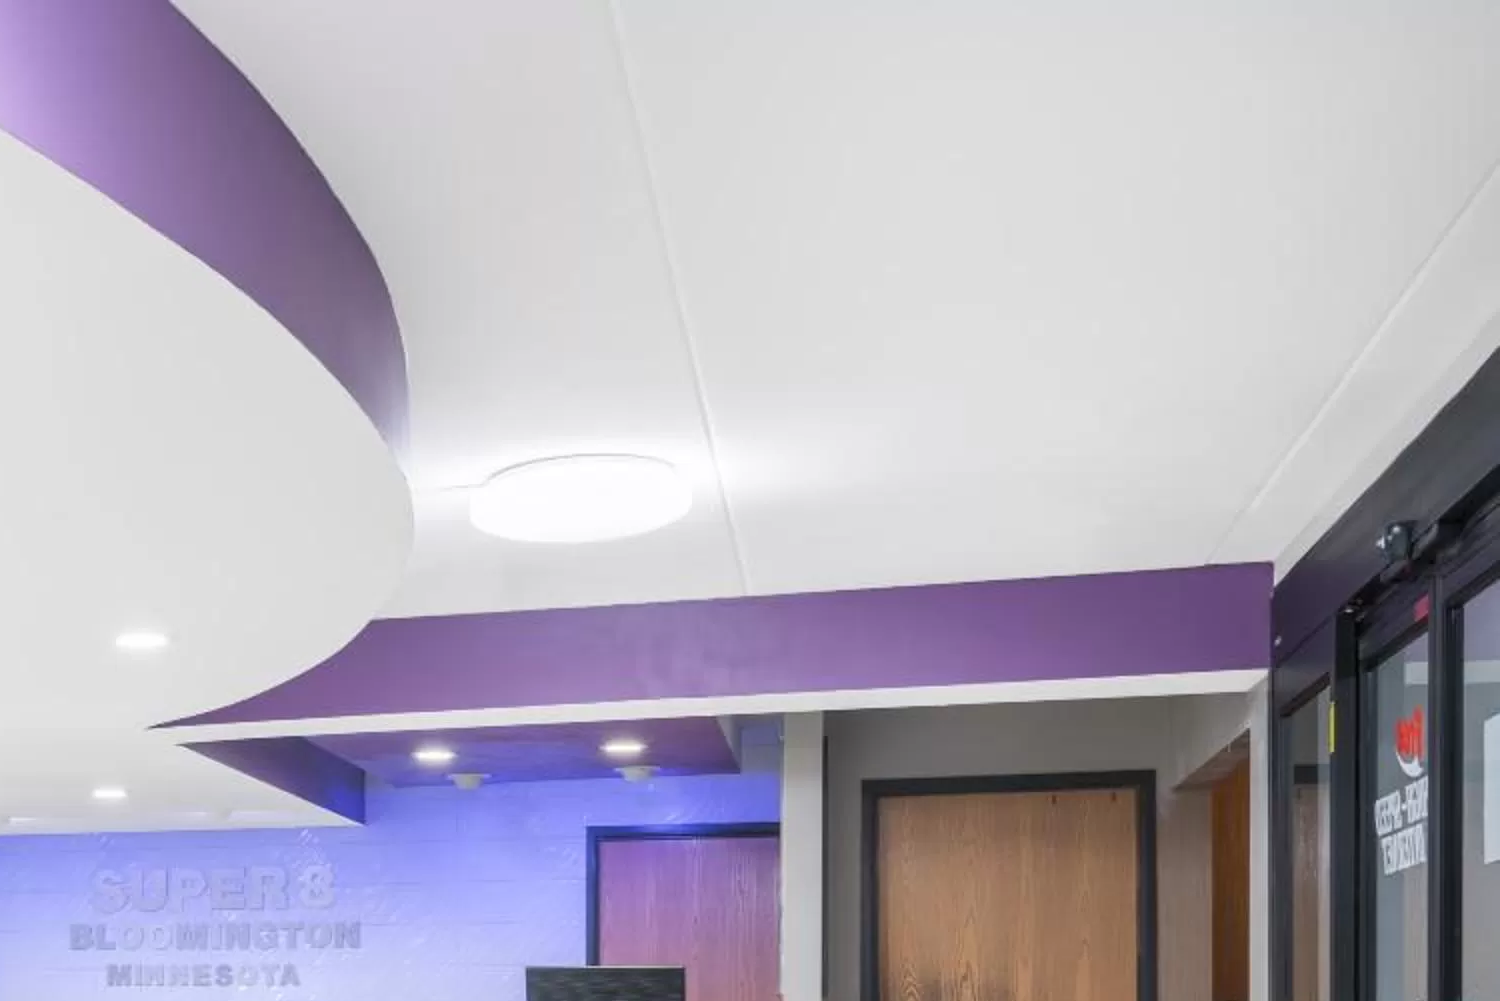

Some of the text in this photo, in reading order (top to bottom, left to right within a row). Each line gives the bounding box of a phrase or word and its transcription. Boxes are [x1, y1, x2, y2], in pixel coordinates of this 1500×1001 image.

[92, 863, 337, 914] SUPER 8
[68, 921, 362, 951] BLOOMINGTON
[105, 963, 302, 988] MINNESOTA
